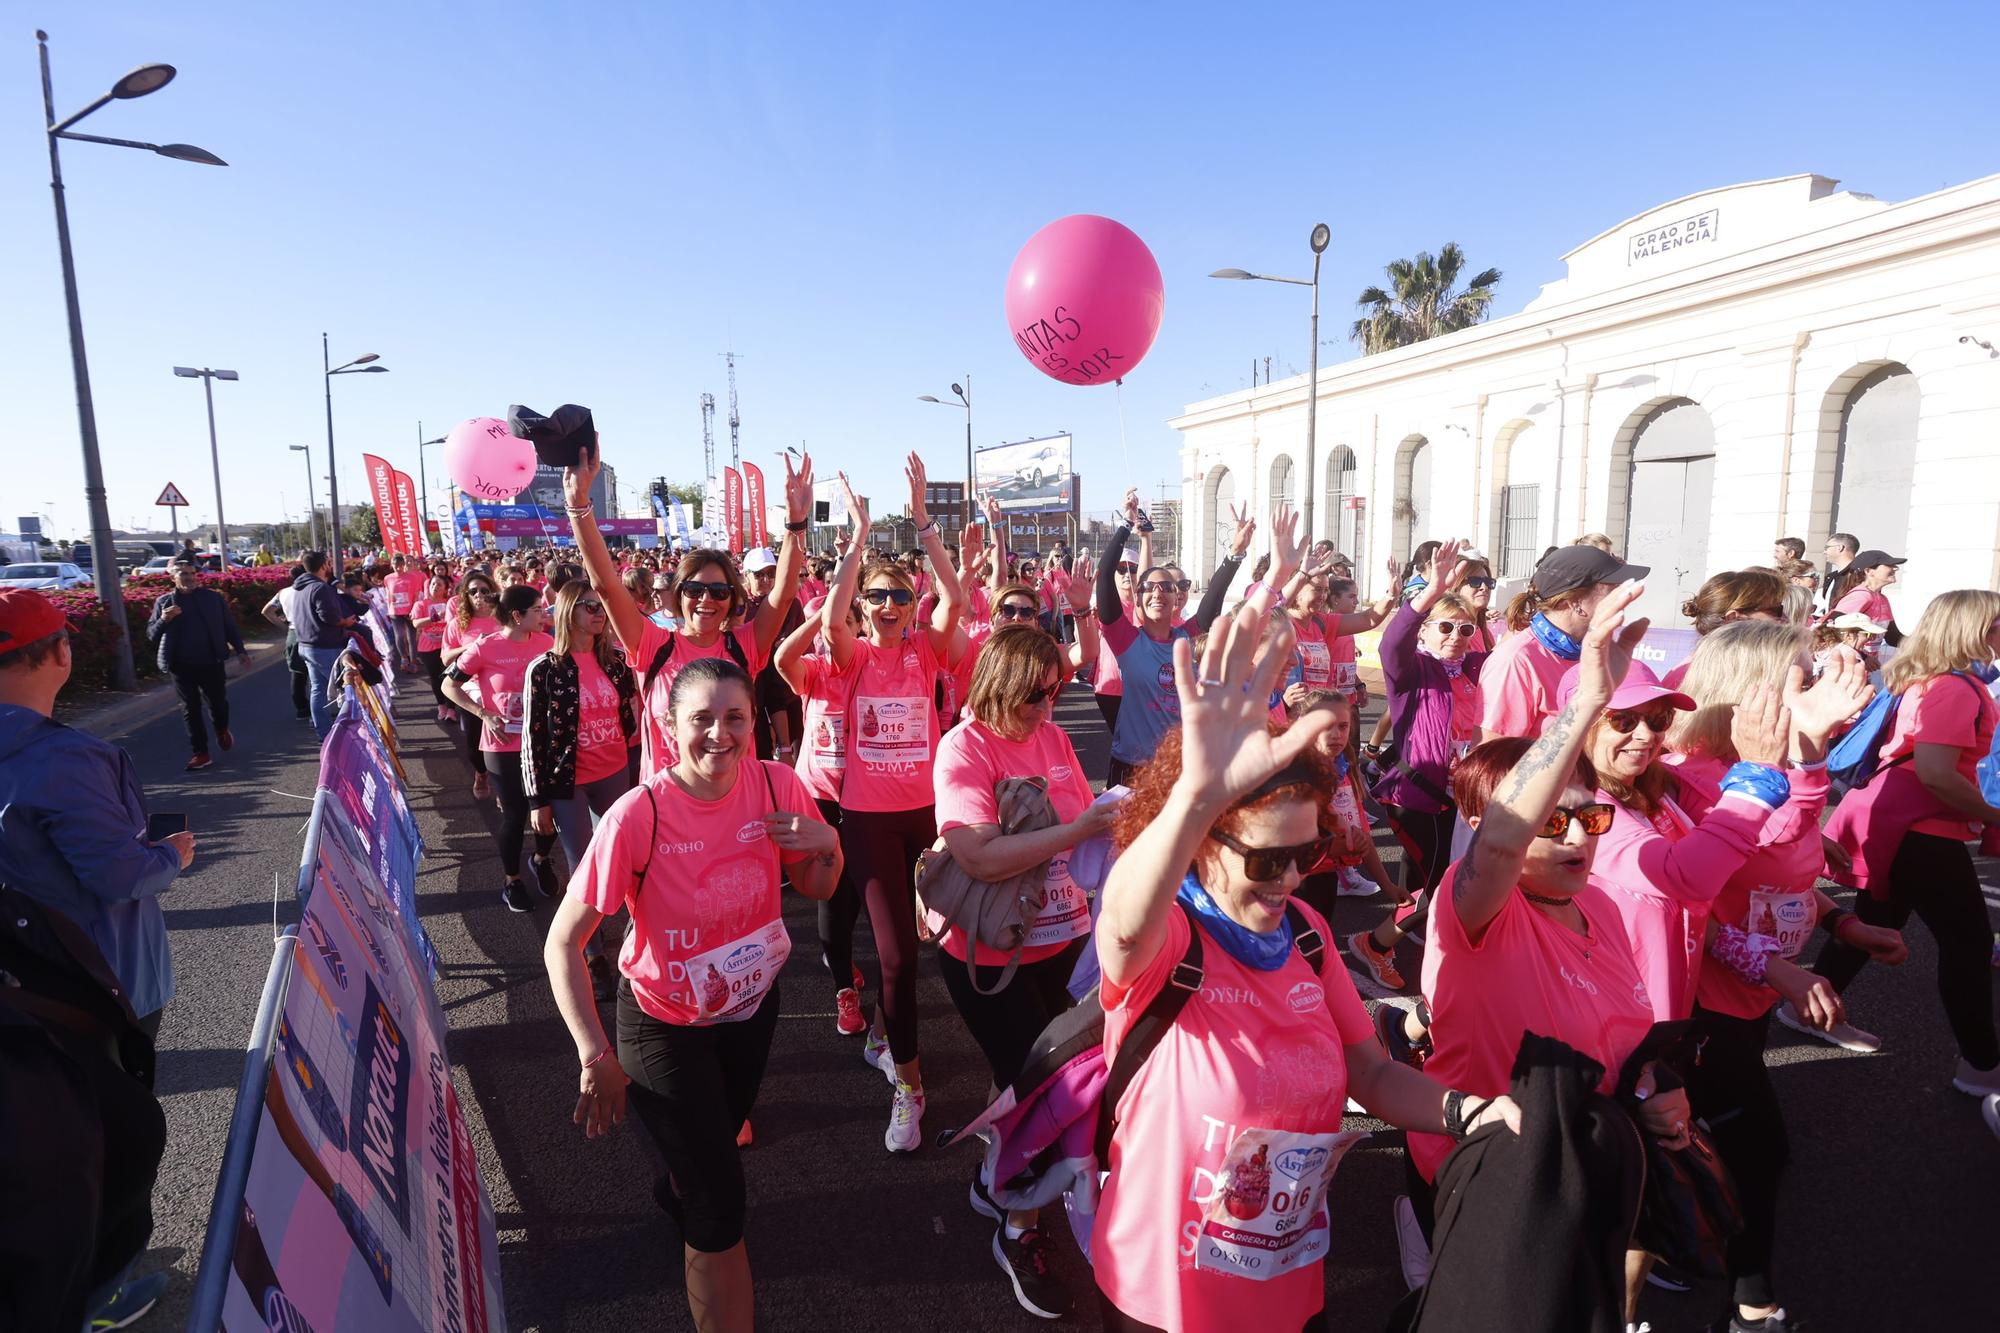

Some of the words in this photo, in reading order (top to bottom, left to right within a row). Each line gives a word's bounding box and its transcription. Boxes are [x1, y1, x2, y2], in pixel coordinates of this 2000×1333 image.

[1637, 227, 1678, 247] GRAO
[1686, 216, 1709, 232] DE
[1633, 228, 1711, 260] VALENCIA
[880, 722, 905, 733] 016
[659, 840, 704, 855] OYSHO
[1050, 885, 1073, 902] 016
[1056, 901, 1072, 912] 6862
[664, 927, 699, 952] TU
[1030, 928, 1060, 940] OYSHO
[727, 949, 764, 970] ASTURIANA
[731, 968, 762, 994] 016
[737, 985, 757, 1001] 3987
[362, 1001, 401, 1202] Norauto
[1272, 1186, 1312, 1214] 016
[1221, 1229, 1267, 1247] CARRERA
[1209, 1246, 1262, 1270] OYSHO
